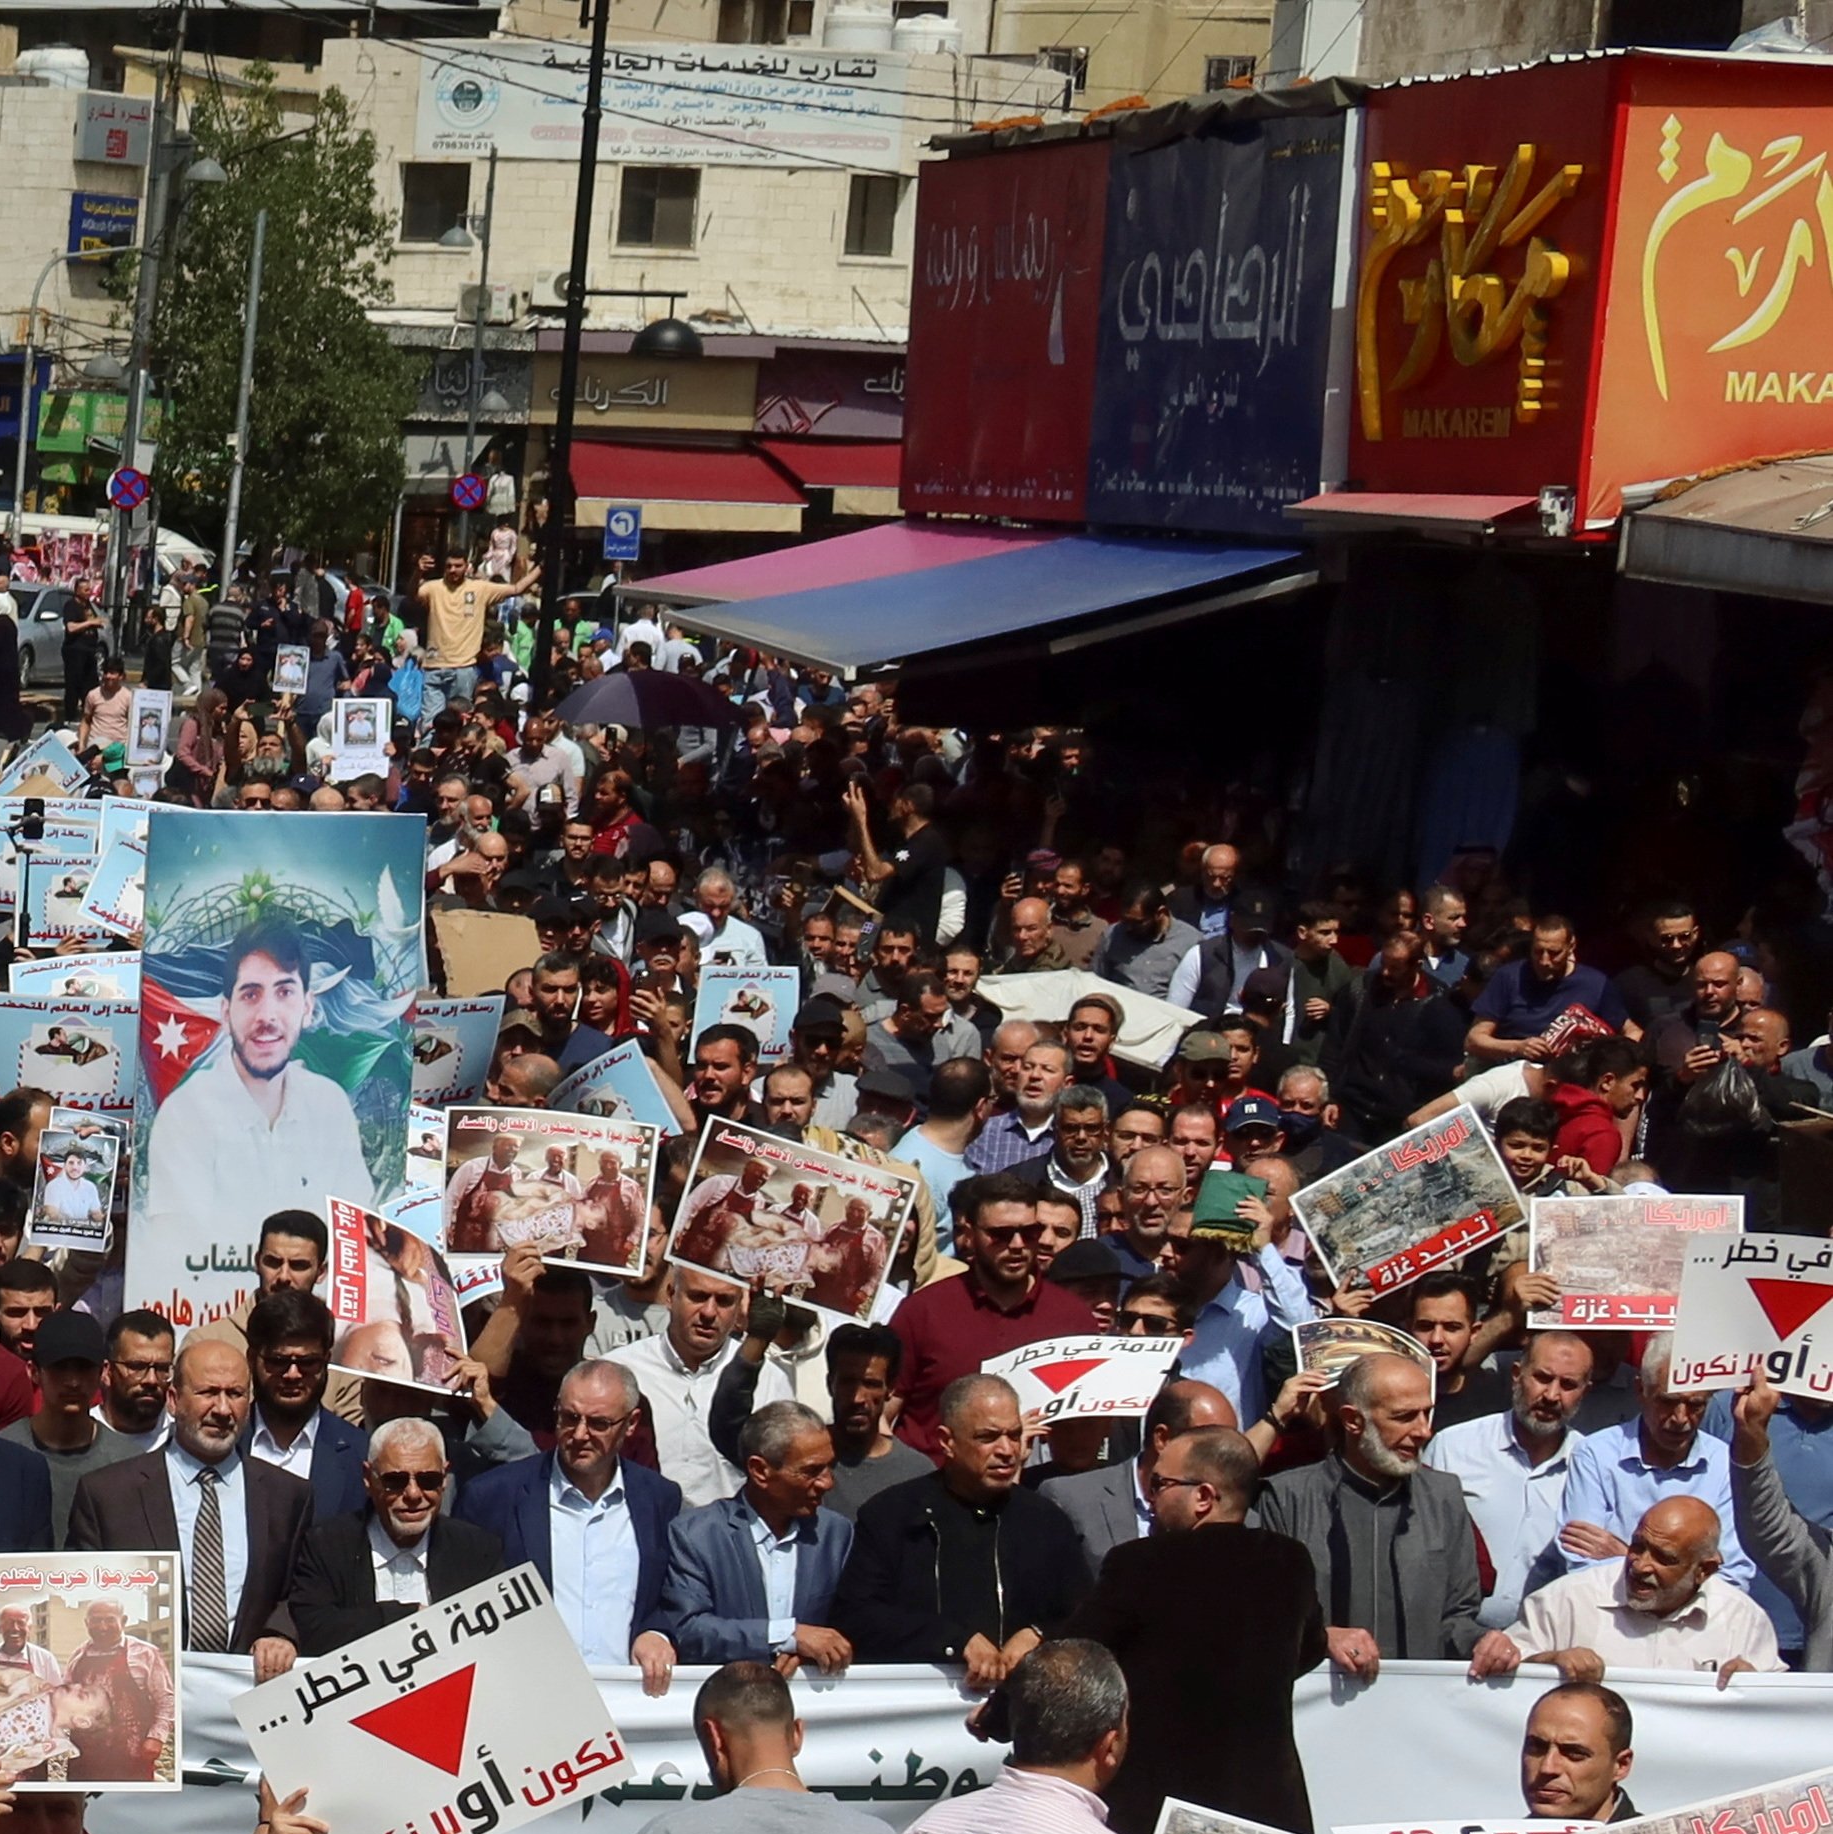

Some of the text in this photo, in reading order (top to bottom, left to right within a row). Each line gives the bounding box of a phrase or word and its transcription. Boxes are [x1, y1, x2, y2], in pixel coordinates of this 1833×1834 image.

[675, 52, 789, 76] للخدمات
[799, 58, 877, 82] تقارب
[1403, 407, 1511, 438] MAKAREM
[456, 1115, 497, 1130] والنساء
[335, 1202, 363, 1319] تقتل أطفال غزة
[1721, 1238, 1833, 1274] في خطر
[1569, 1299, 1608, 1327] غزة
[1005, 1335, 1178, 1374] الأمة في خطر
[1671, 1336, 1810, 1387] أو نكون
[295, 1572, 545, 1726] الأمة في خطر
